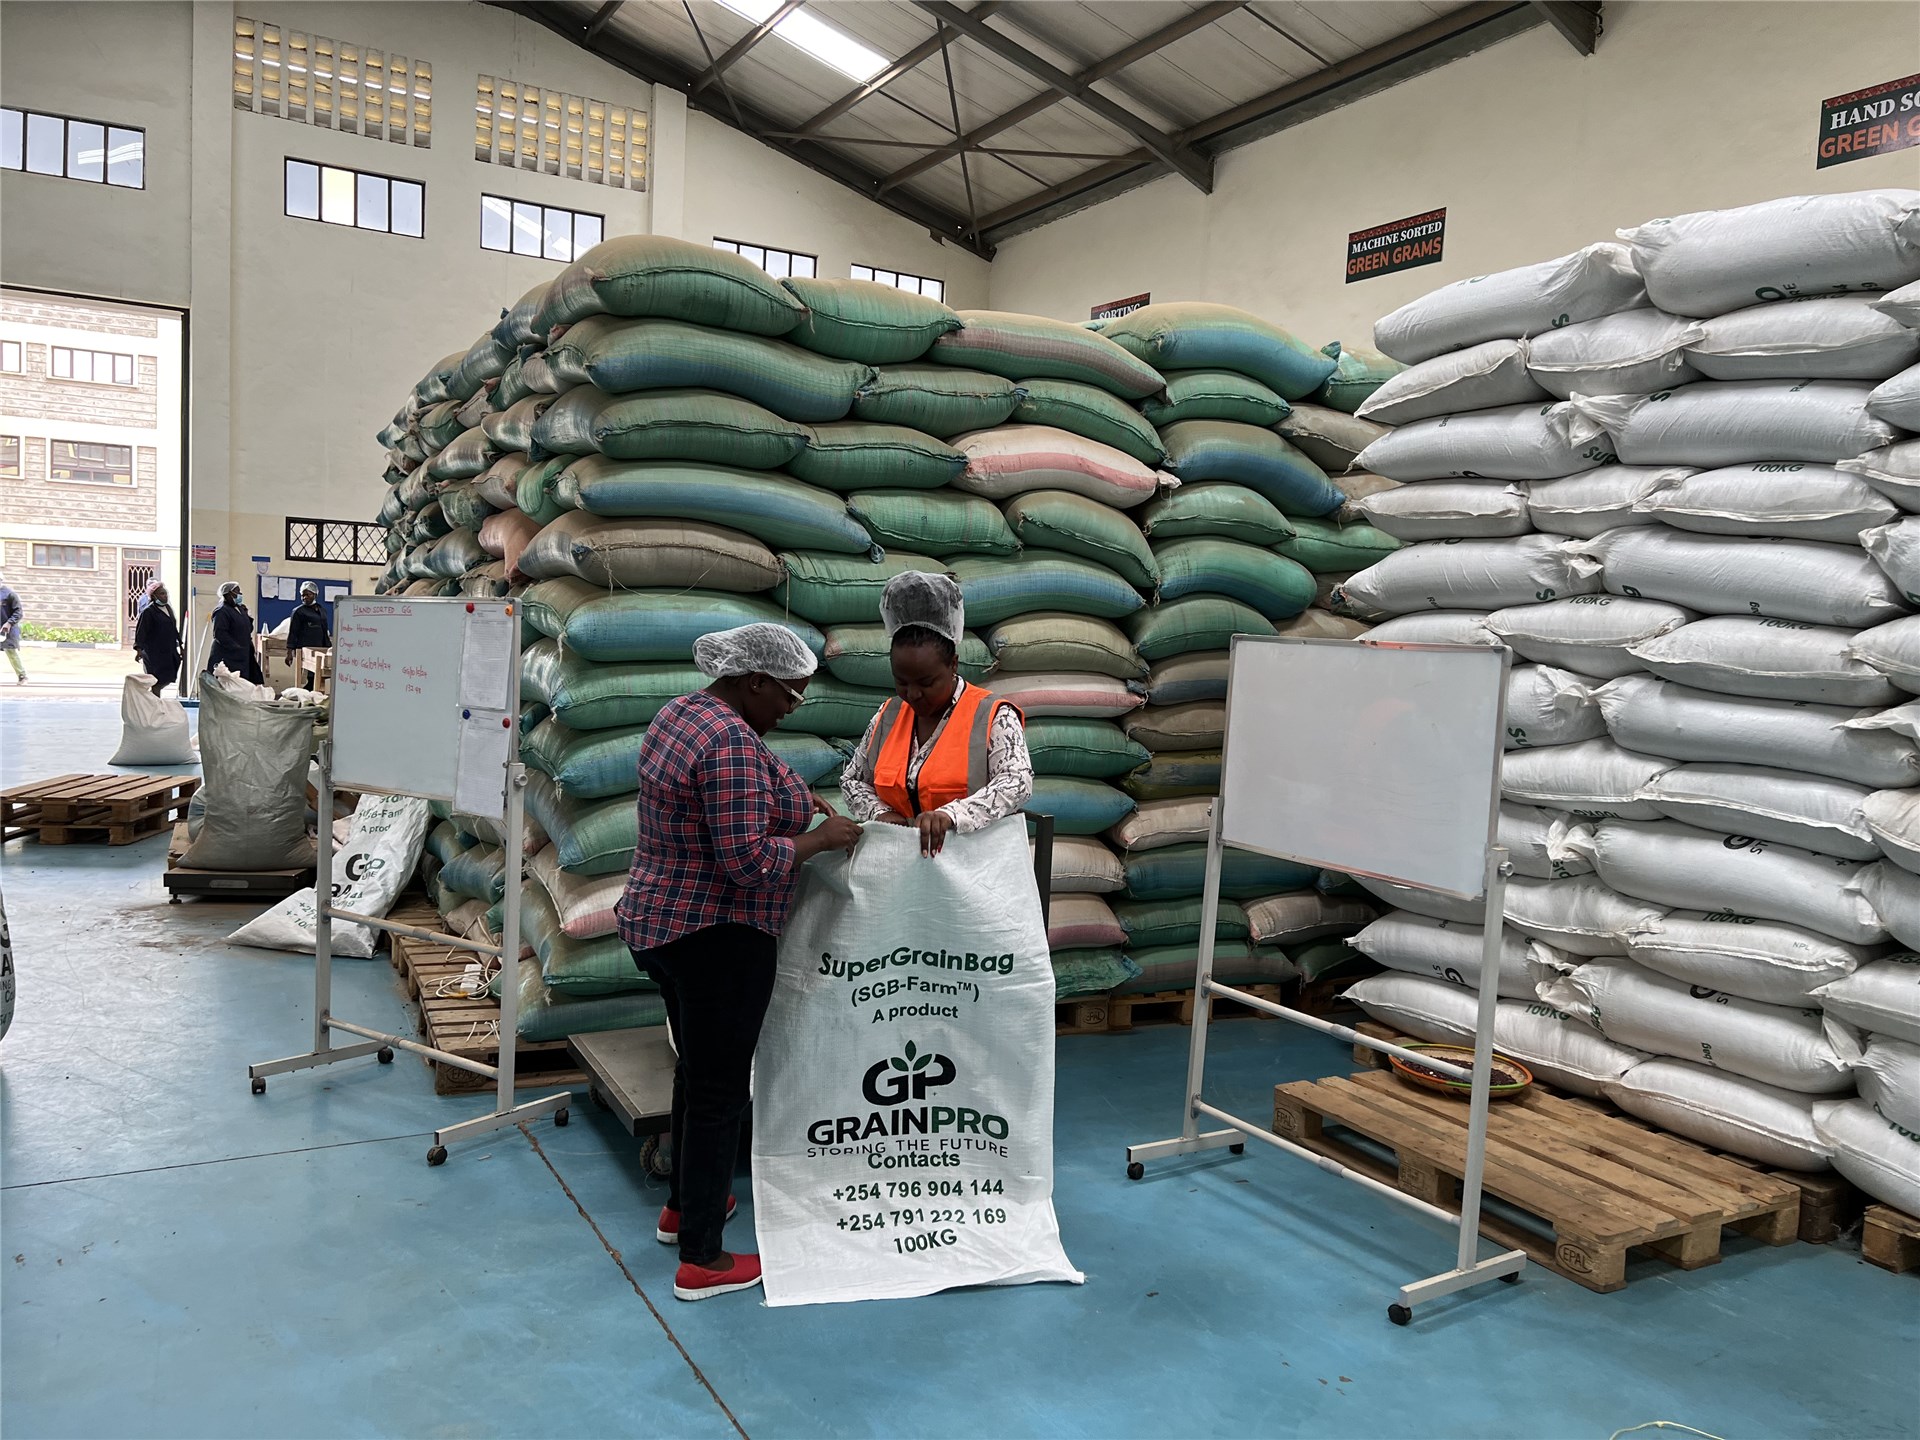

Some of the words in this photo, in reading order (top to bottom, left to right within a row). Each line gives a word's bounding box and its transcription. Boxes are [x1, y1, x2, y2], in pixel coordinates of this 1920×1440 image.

[1830, 98, 1896, 130] HAND
[1820, 120, 1899, 158] GREEN
[1351, 232, 1399, 254] MACHINE
[1400, 221, 1442, 241] SORTED
[1347, 250, 1390, 275] GREEN
[1392, 236, 1442, 264] GRAMS
[1752, 463, 1805, 473] 100KG
[1569, 596, 1612, 606] 100KG
[1702, 911, 1757, 925] 100KG
[818, 946, 1014, 981] SuperGrainBag
[871, 1009, 884, 1024] A
[889, 1003, 959, 1022] product
[1525, 1003, 1571, 1021] 100KG
[807, 1106, 1009, 1146] GRAINPRO
[807, 1141, 886, 1158] STORING
[896, 1139, 930, 1153] THE
[939, 1138, 1009, 1158] FUTURE
[867, 1150, 961, 1170] Contacts
[833, 1182, 881, 1202] +254
[886, 1180, 922, 1198] 796
[928, 1180, 963, 1196] 904
[970, 1179, 1004, 1196] 144
[837, 1211, 885, 1232] +254
[890, 1208, 924, 1227] 791
[931, 1209, 966, 1225] 222
[972, 1208, 1007, 1225] 169
[894, 1229, 957, 1254] 100KG
[1563, 1247, 1589, 1271] EPAL
